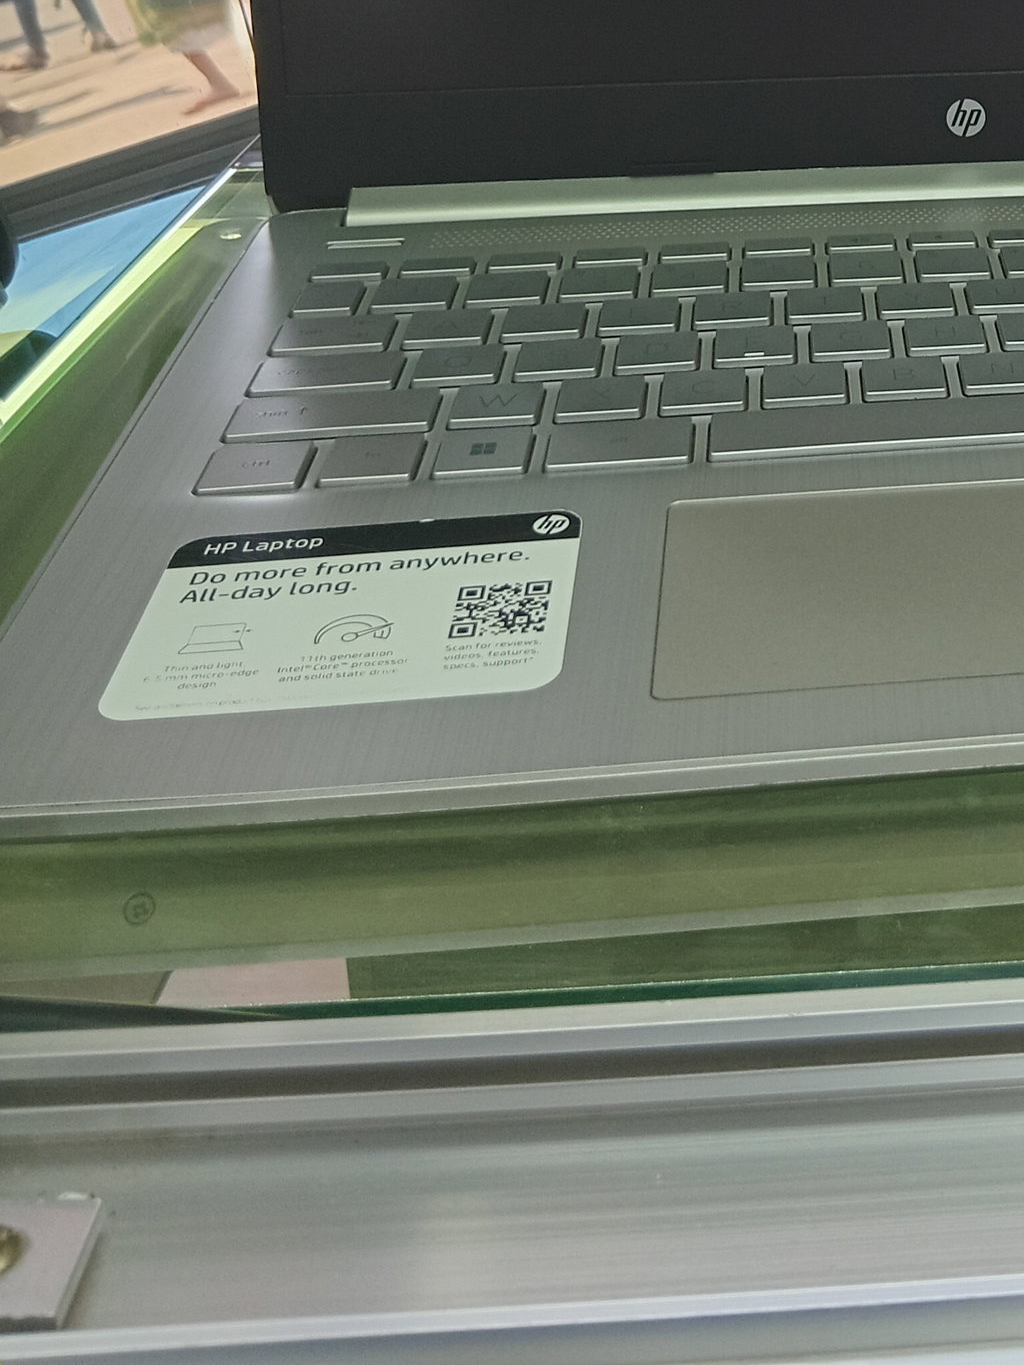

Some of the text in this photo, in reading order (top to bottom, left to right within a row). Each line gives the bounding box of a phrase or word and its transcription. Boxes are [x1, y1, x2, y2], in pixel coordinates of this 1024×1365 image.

[946, 99, 986, 137] hp
[532, 514, 571, 535] hp
[203, 535, 324, 555] HP Laptop
[188, 547, 532, 585] Do more from anywhere.
[179, 579, 358, 604] All-day long.
[445, 642, 473, 652] Scan
[475, 640, 492, 650] for
[300, 647, 394, 663] 11th generation
[351, 656, 408, 668] processor
[164, 664, 190, 673] Thin
[191, 663, 214, 672] and
[190, 667, 260, 680] micro-edge
[278, 666, 398, 683] and solid state drive
[177, 680, 217, 690] design
